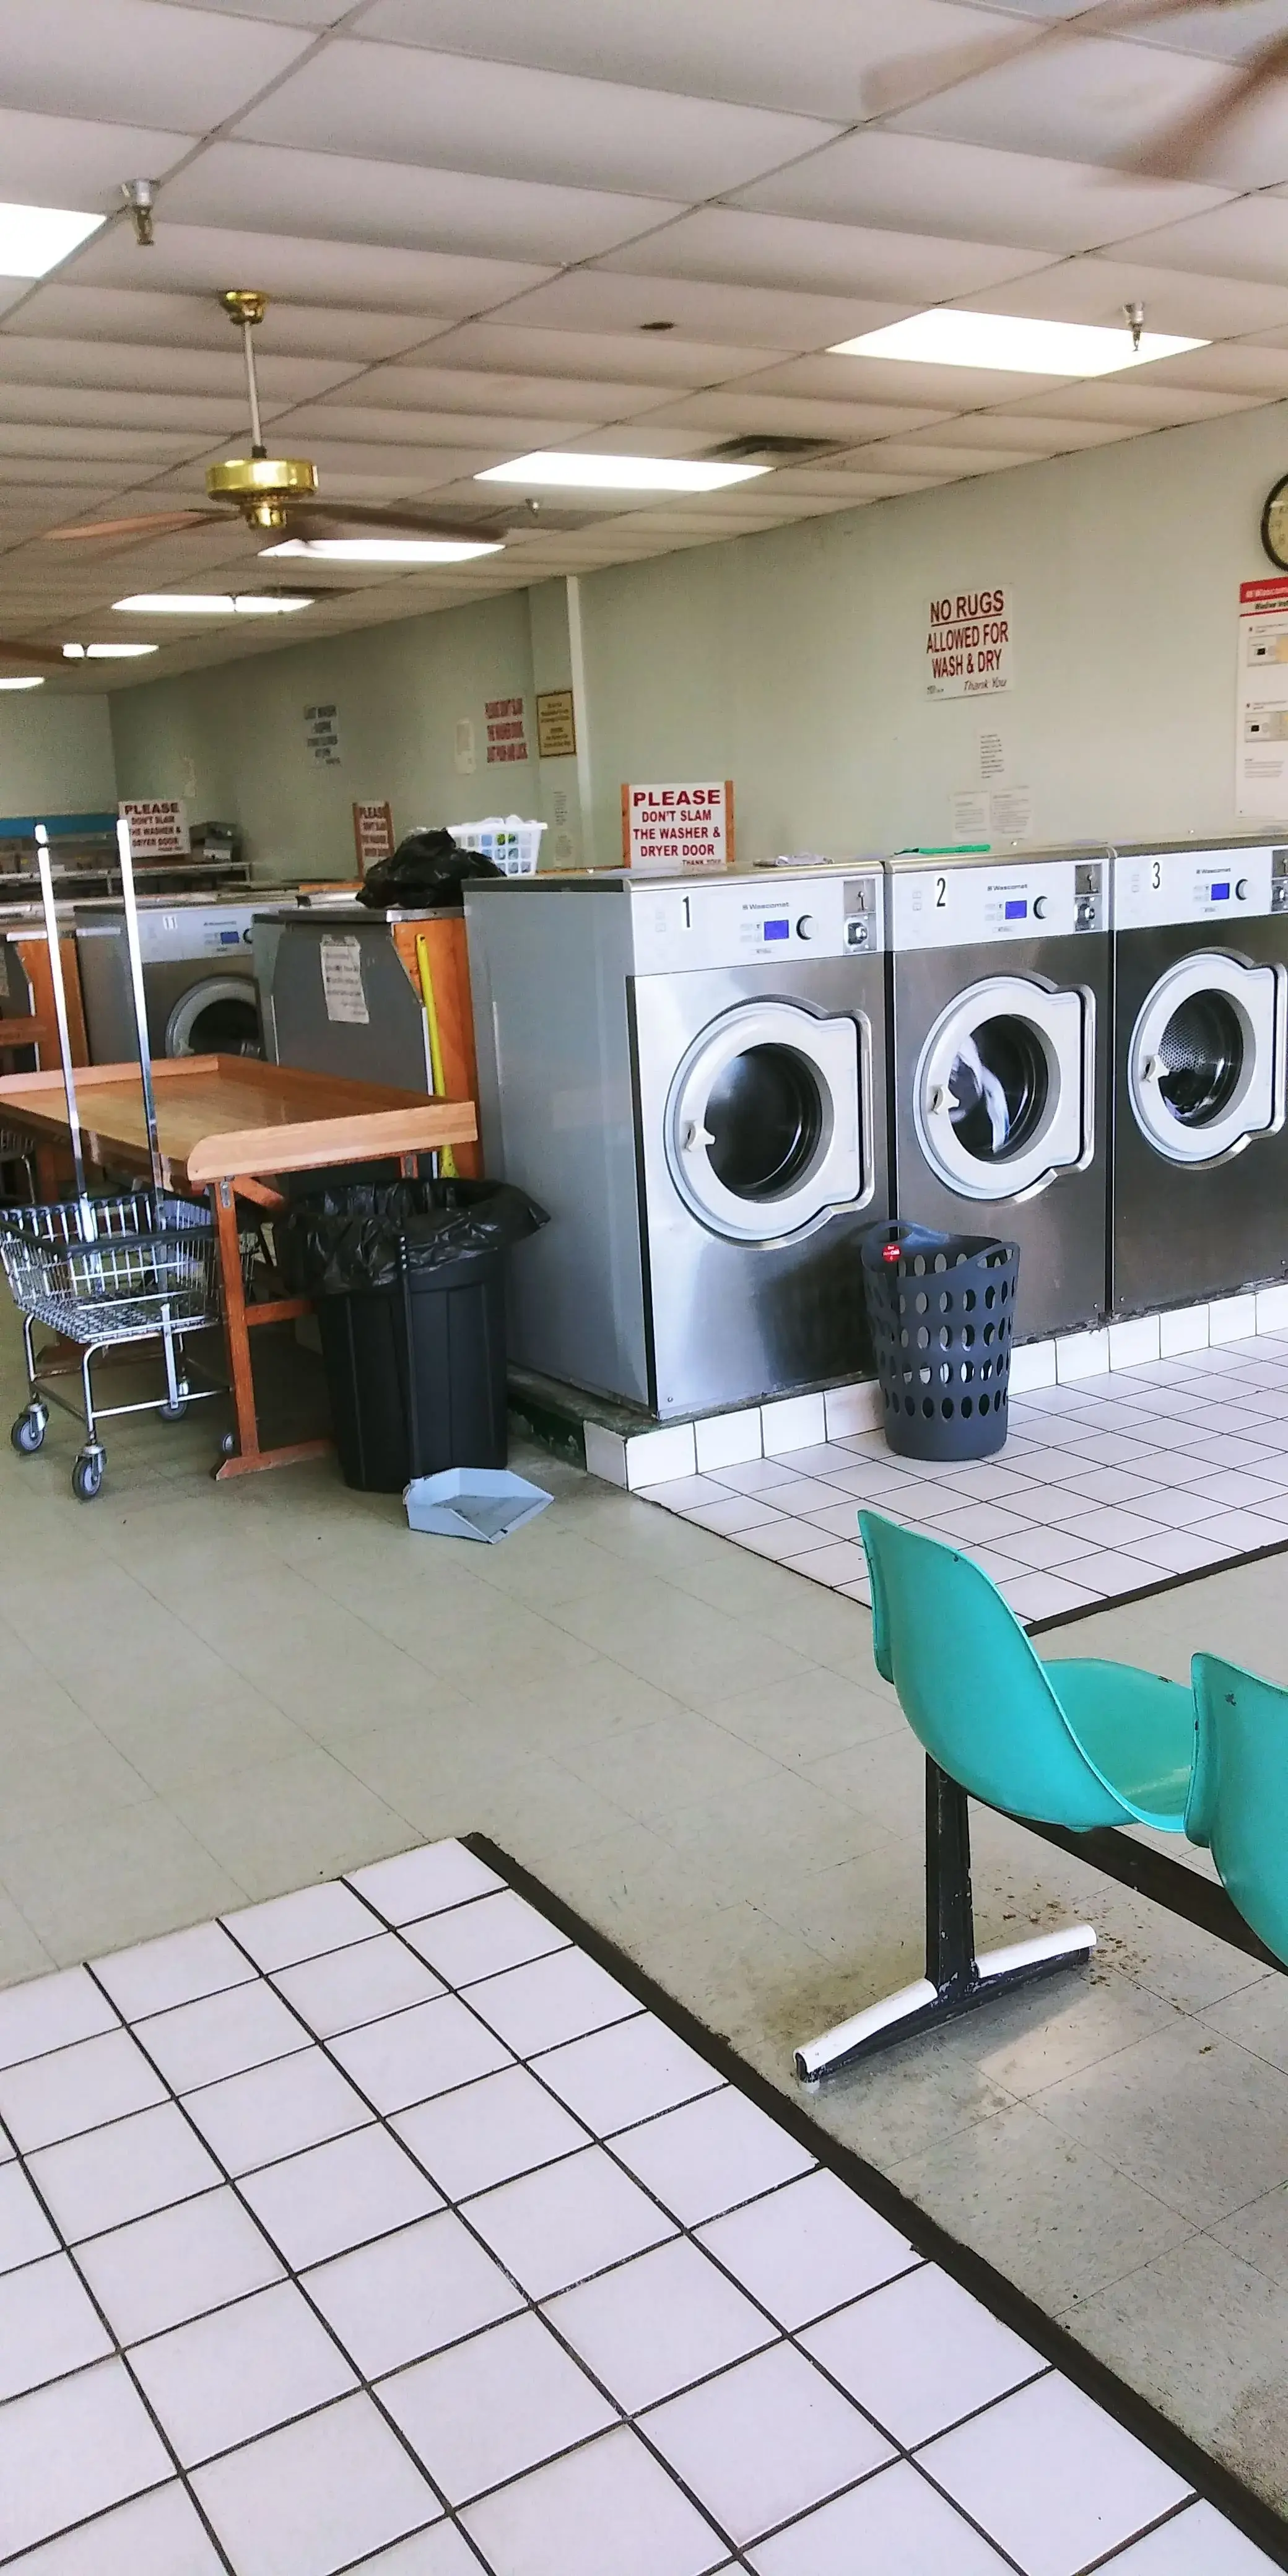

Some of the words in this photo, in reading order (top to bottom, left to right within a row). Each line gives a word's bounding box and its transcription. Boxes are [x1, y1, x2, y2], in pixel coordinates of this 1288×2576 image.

[930, 599, 951, 623] NO
[957, 590, 1004, 618] RUGS
[926, 625, 980, 654] ALLOWED
[983, 621, 1009, 645] FOR
[932, 655, 964, 679] WASH
[967, 653, 974, 674] &
[978, 648, 1002, 672] DRY
[964, 680, 989, 692] Thank
[992, 676, 1007, 689] You
[124, 803, 180, 815] PLEASE
[633, 790, 721, 807] PLEASE
[642, 811, 676, 822] DON'T
[681, 809, 711, 822] SLAM
[633, 829, 656, 840] THE
[659, 827, 708, 839] WASHER
[713, 826, 721, 838] &
[640, 845, 679, 856] DRYER
[682, 844, 715, 856] DOOR
[1152, 861, 1160, 889] 3
[936, 877, 946, 907] 2
[682, 895, 690, 928] 1
